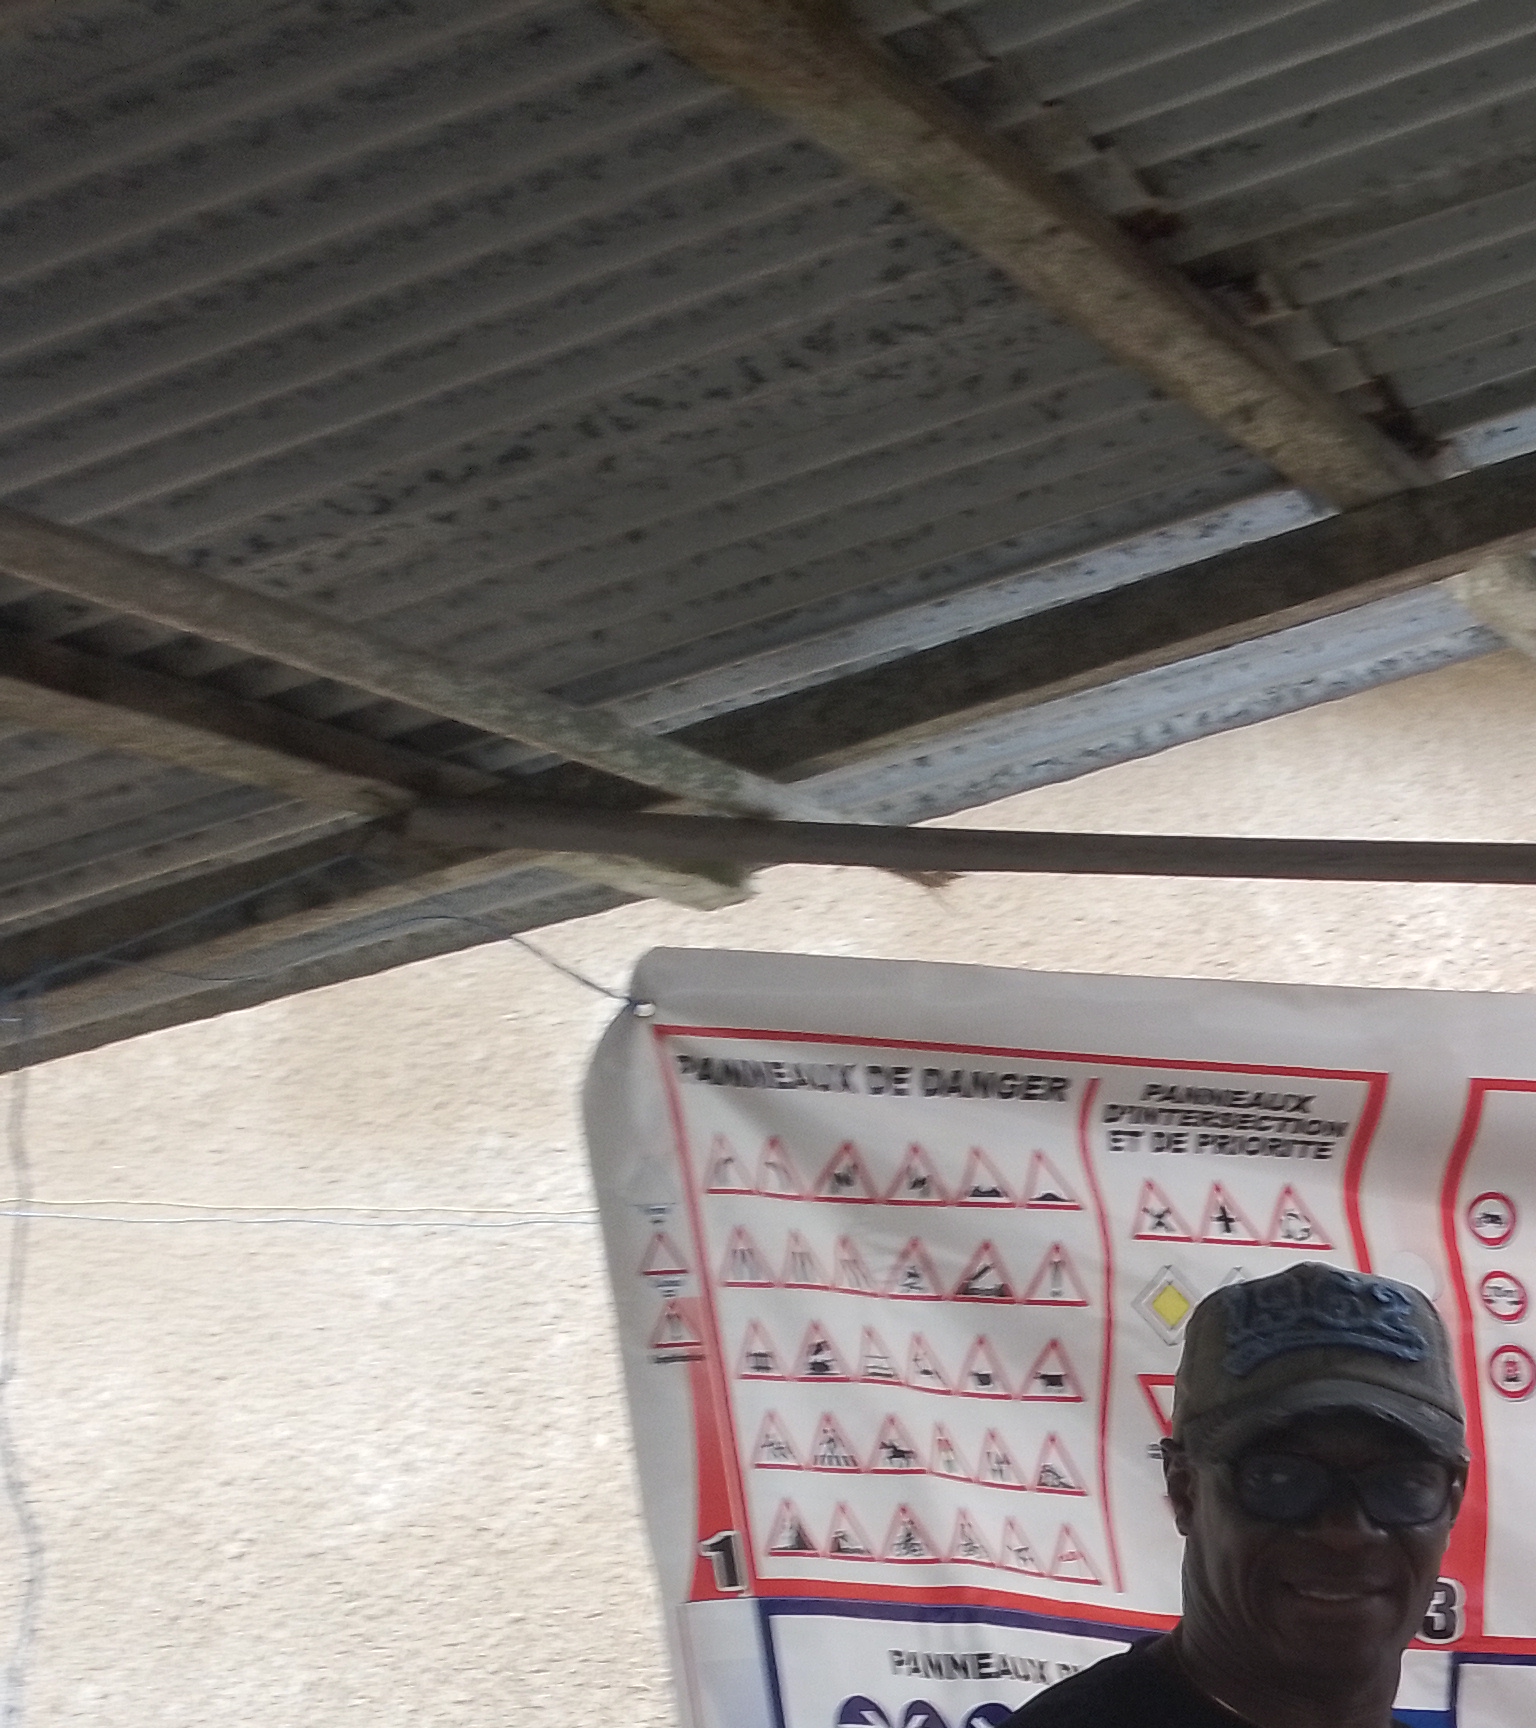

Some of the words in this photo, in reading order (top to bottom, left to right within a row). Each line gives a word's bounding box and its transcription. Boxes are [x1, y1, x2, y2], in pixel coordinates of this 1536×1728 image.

[865, 1063, 912, 1096] DE
[922, 1066, 1072, 1103] DANGER
[1140, 1082, 1318, 1114] PANNEAUX
[1151, 1130, 1190, 1154] DE
[703, 1532, 744, 1593] 1
[1417, 1580, 1460, 1642] 3
